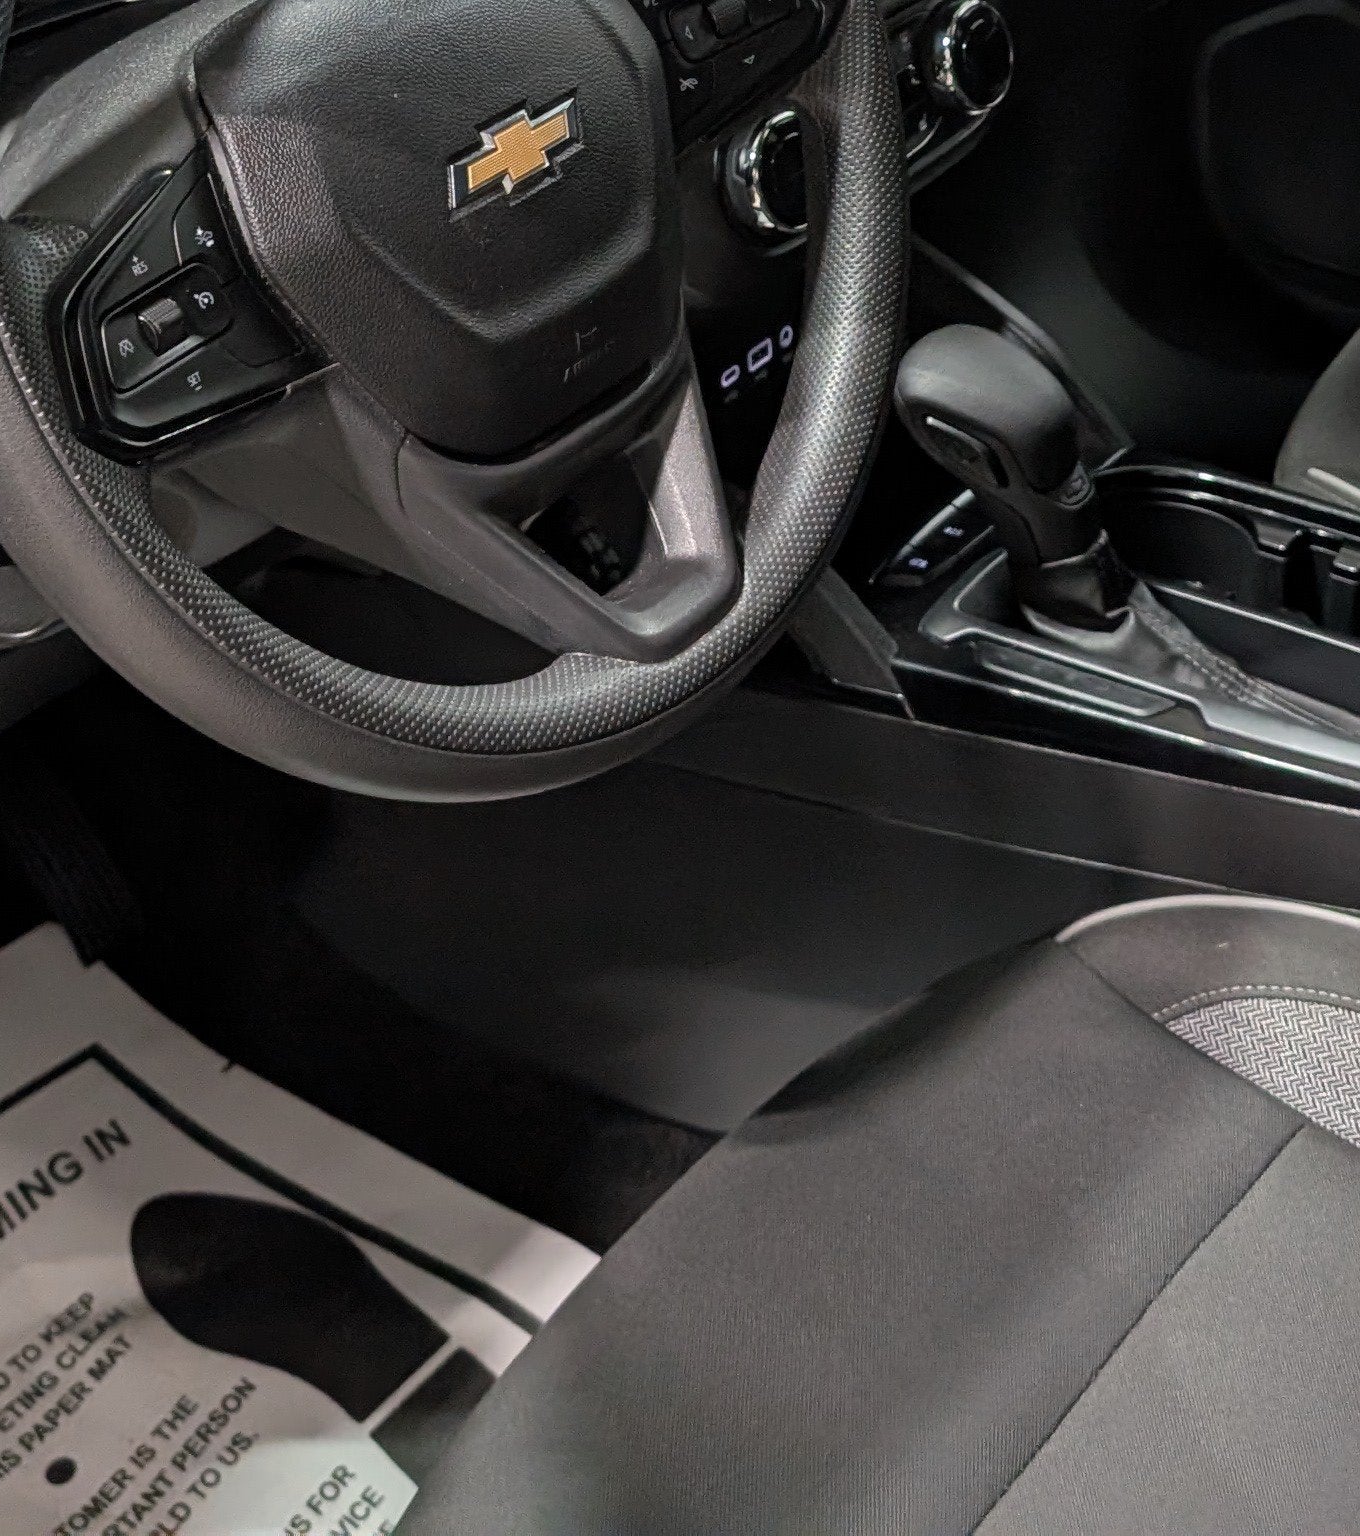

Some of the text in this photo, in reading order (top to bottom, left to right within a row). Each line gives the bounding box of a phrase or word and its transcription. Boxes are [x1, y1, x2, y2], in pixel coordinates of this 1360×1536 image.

[81, 1117, 132, 1163] IN
[6, 1343, 42, 1372] TO
[40, 1291, 95, 1345] KEEP
[18, 1381, 94, 1453] PAPER
[88, 1333, 133, 1382] MAT
[128, 1443, 158, 1470] IS
[150, 1393, 201, 1442] THE
[171, 1375, 258, 1472] PERSON
[186, 1466, 222, 1500] TO
[218, 1430, 261, 1466] US.
[305, 1464, 357, 1516] FOR
